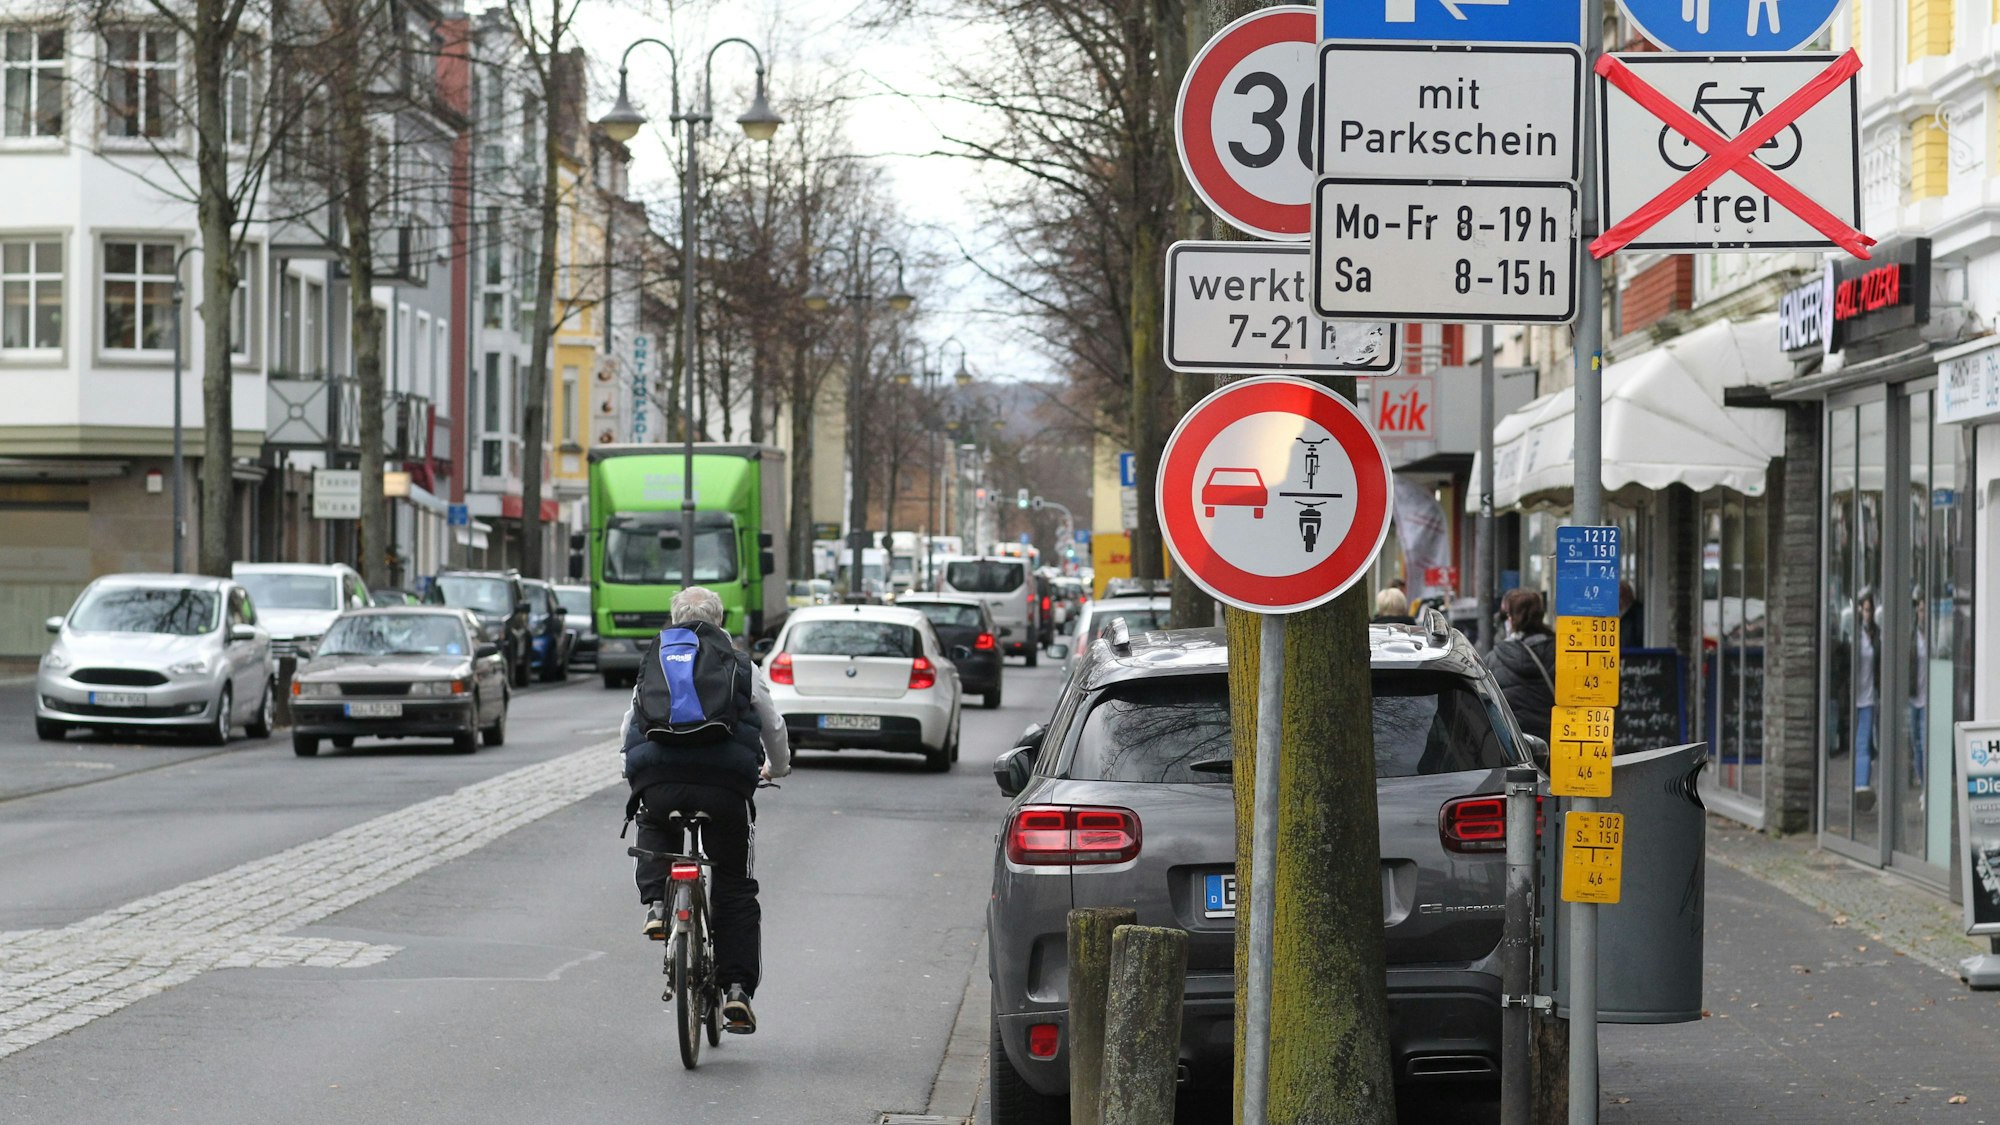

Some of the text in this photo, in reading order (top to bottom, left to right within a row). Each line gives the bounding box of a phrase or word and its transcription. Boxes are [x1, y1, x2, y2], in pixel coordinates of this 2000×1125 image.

[1419, 77, 1480, 109] mit
[1341, 120, 1557, 155] Parkschein
[1694, 186, 1770, 223] frei
[1335, 256, 1372, 293] Sa
[1188, 268, 1305, 302] werkt
[1378, 384, 1428, 432] kik
[1584, 529, 1616, 543] 1212
[1568, 544, 1576, 557] S
[1593, 544, 1616, 557] 150
[1592, 620, 1616, 632] 503
[1569, 634, 1576, 647] S
[1593, 635, 1615, 647] 100
[1584, 676, 1599, 690] 4,3
[1587, 710, 1610, 722] 504
[1563, 725, 1570, 736] S
[1587, 725, 1609, 737] 150
[1578, 766, 1592, 780] 4,6
[1599, 816, 1620, 829] 502
[1576, 830, 1583, 843] S
[1599, 831, 1619, 844] 150
[1588, 872, 1603, 886] 4,6
